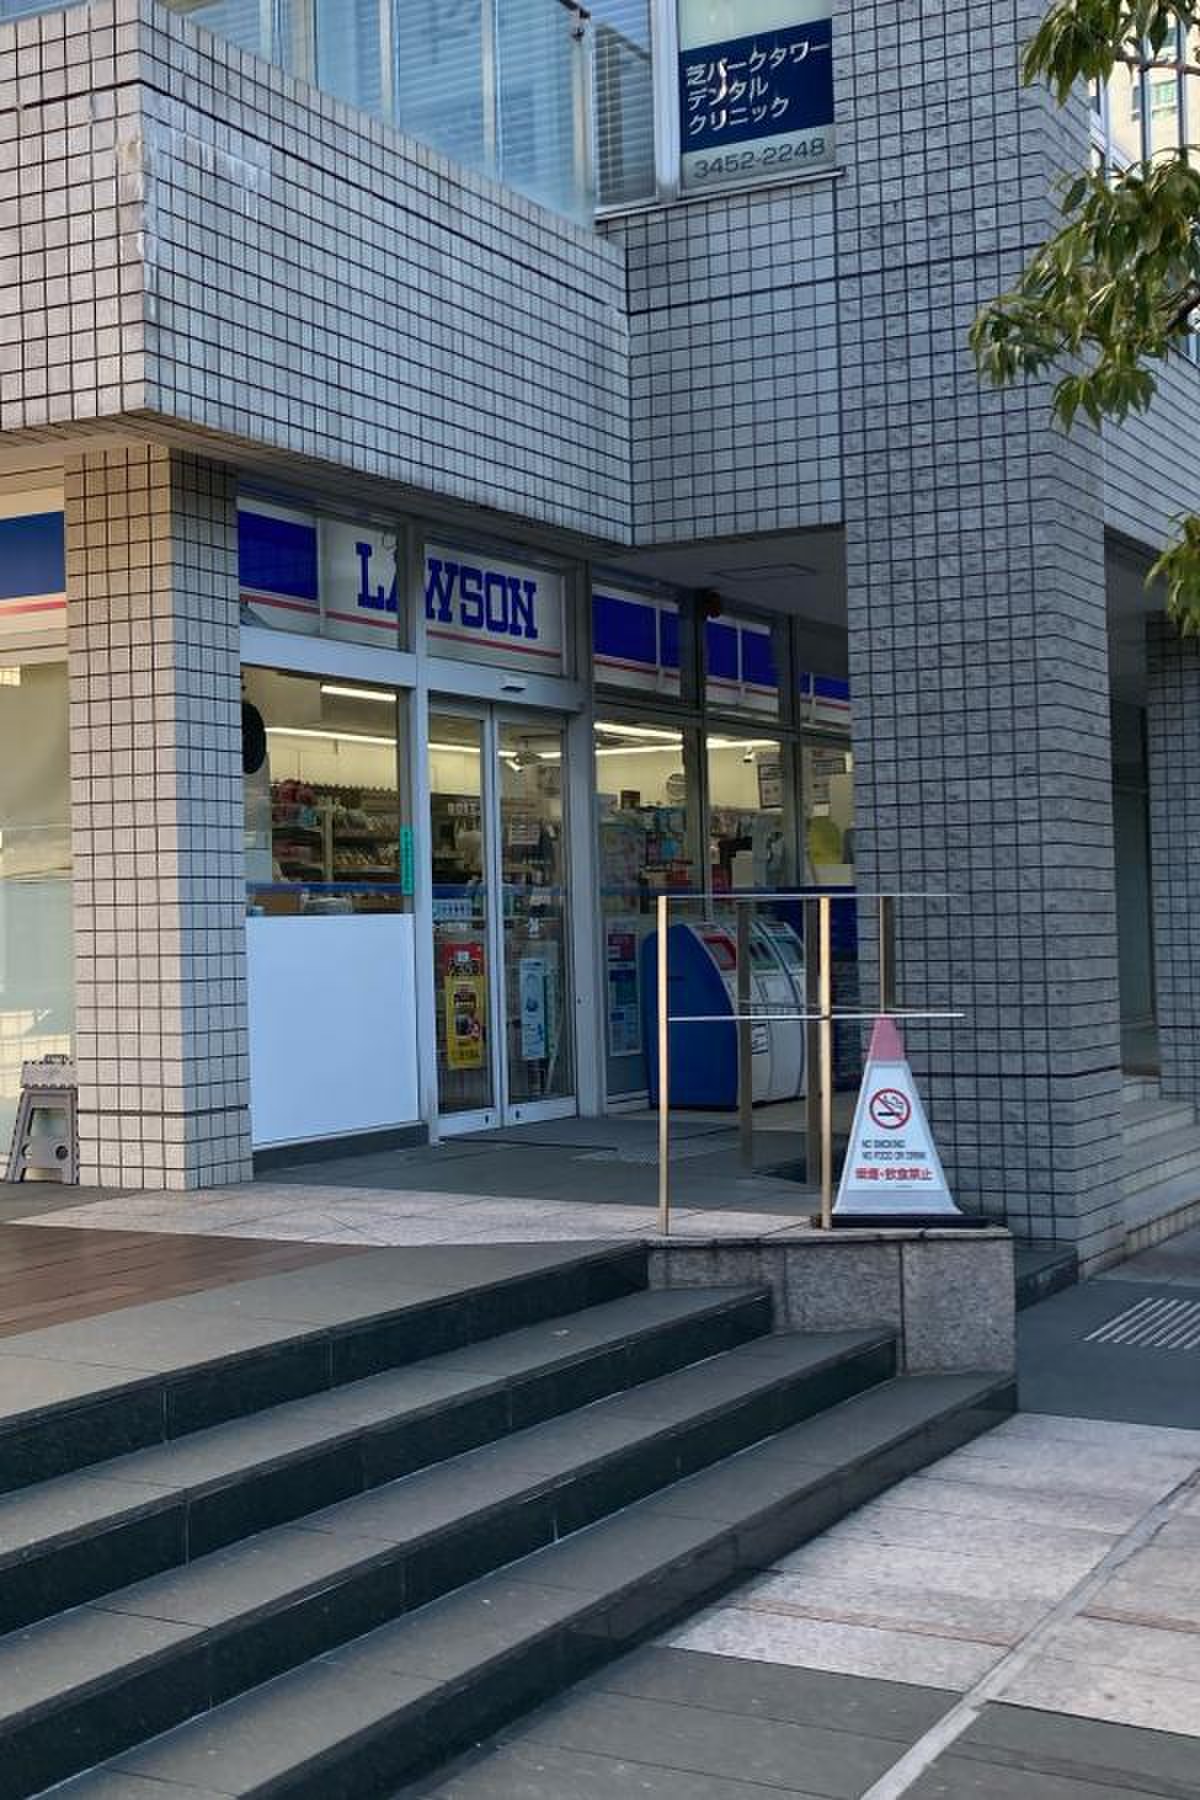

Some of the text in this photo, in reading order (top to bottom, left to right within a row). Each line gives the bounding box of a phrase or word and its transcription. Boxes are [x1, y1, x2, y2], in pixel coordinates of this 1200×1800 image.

[686, 40, 830, 87] 芝パークタワー
[687, 76, 769, 111] デンタル
[688, 96, 789, 136] クリニック
